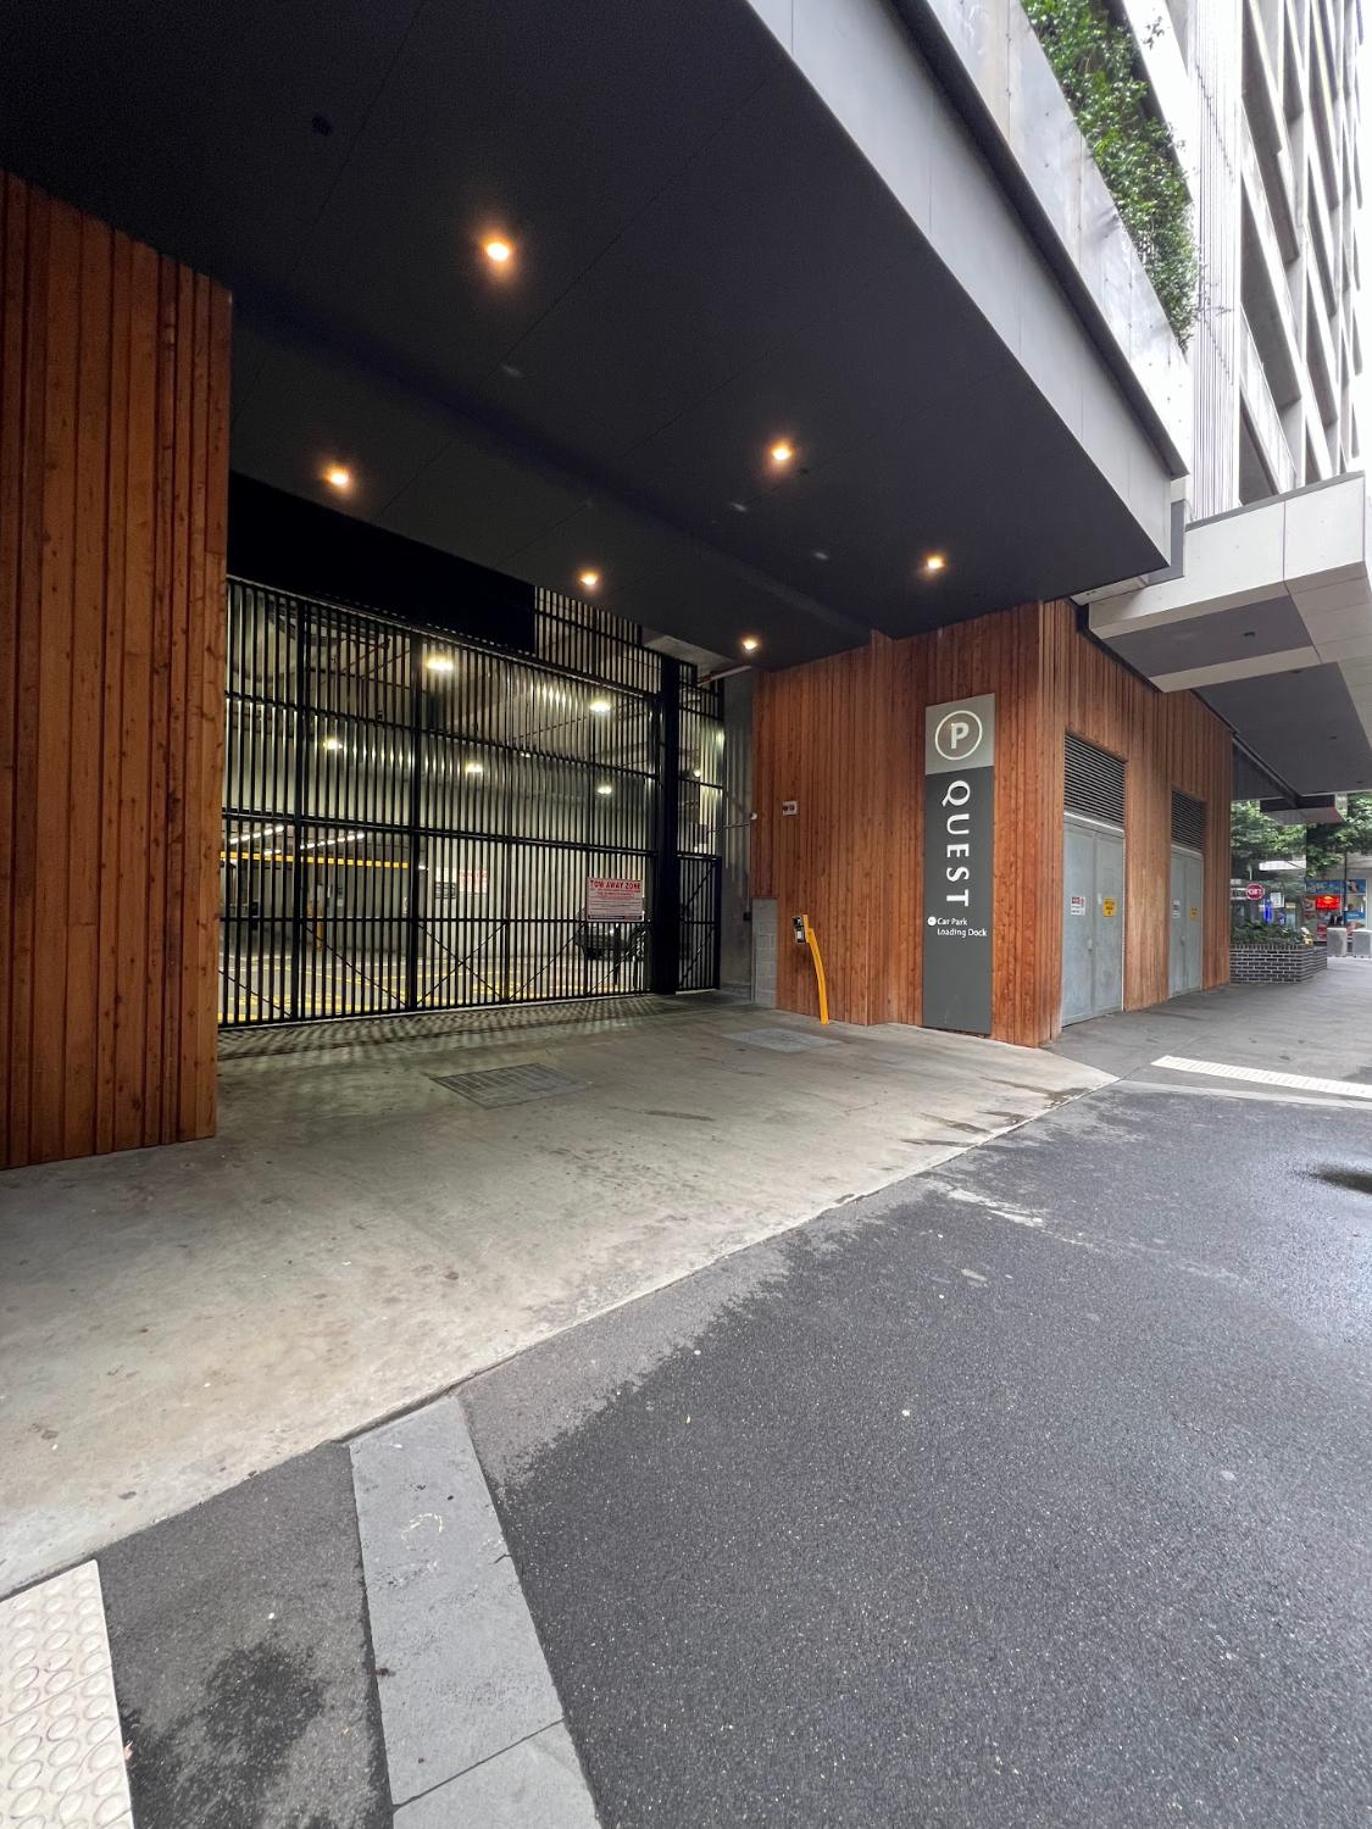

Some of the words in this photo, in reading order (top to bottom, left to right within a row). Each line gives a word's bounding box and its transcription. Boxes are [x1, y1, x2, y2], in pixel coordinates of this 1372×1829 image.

[950, 721, 969, 749] P
[941, 780, 971, 907] QUEST
[605, 881, 624, 889] AWAY
[624, 882, 641, 890] ZONE
[937, 917, 950, 925] Car
[950, 917, 968, 926] Park
[937, 928, 967, 939] Loading
[967, 928, 988, 937] Dock
